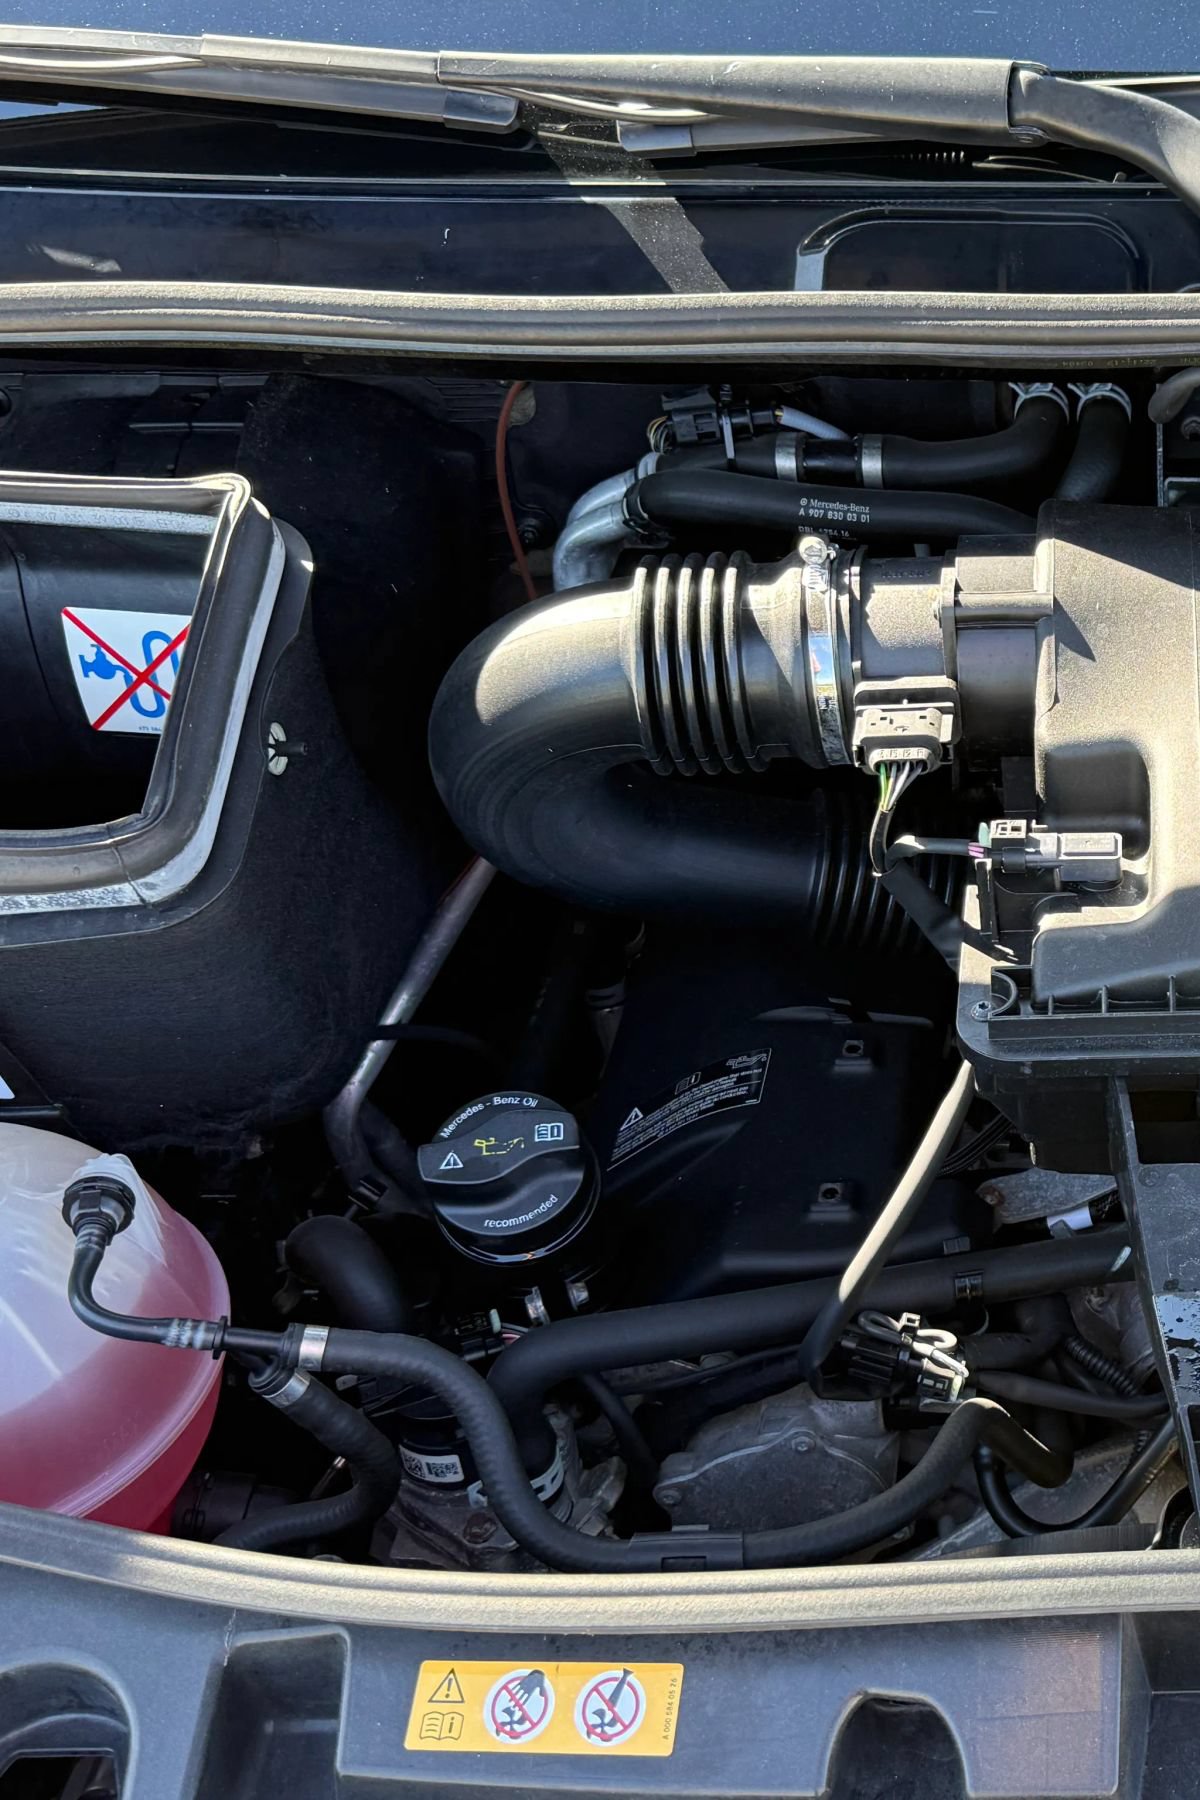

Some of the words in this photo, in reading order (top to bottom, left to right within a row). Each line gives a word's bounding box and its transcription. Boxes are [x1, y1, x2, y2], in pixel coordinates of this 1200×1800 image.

[809, 498, 870, 513] Mercedes-Benz
[798, 507, 805, 516] A
[809, 508, 824, 518] 907
[827, 511, 843, 521] 830
[847, 512, 857, 522] 03
[860, 514, 870, 523] 01
[439, 1102, 485, 1139] Mercedes
[492, 1096, 521, 1106] Benz
[522, 1097, 539, 1108] Oil
[483, 1194, 558, 1229] recommended
[663, 1717, 672, 1733] 000
